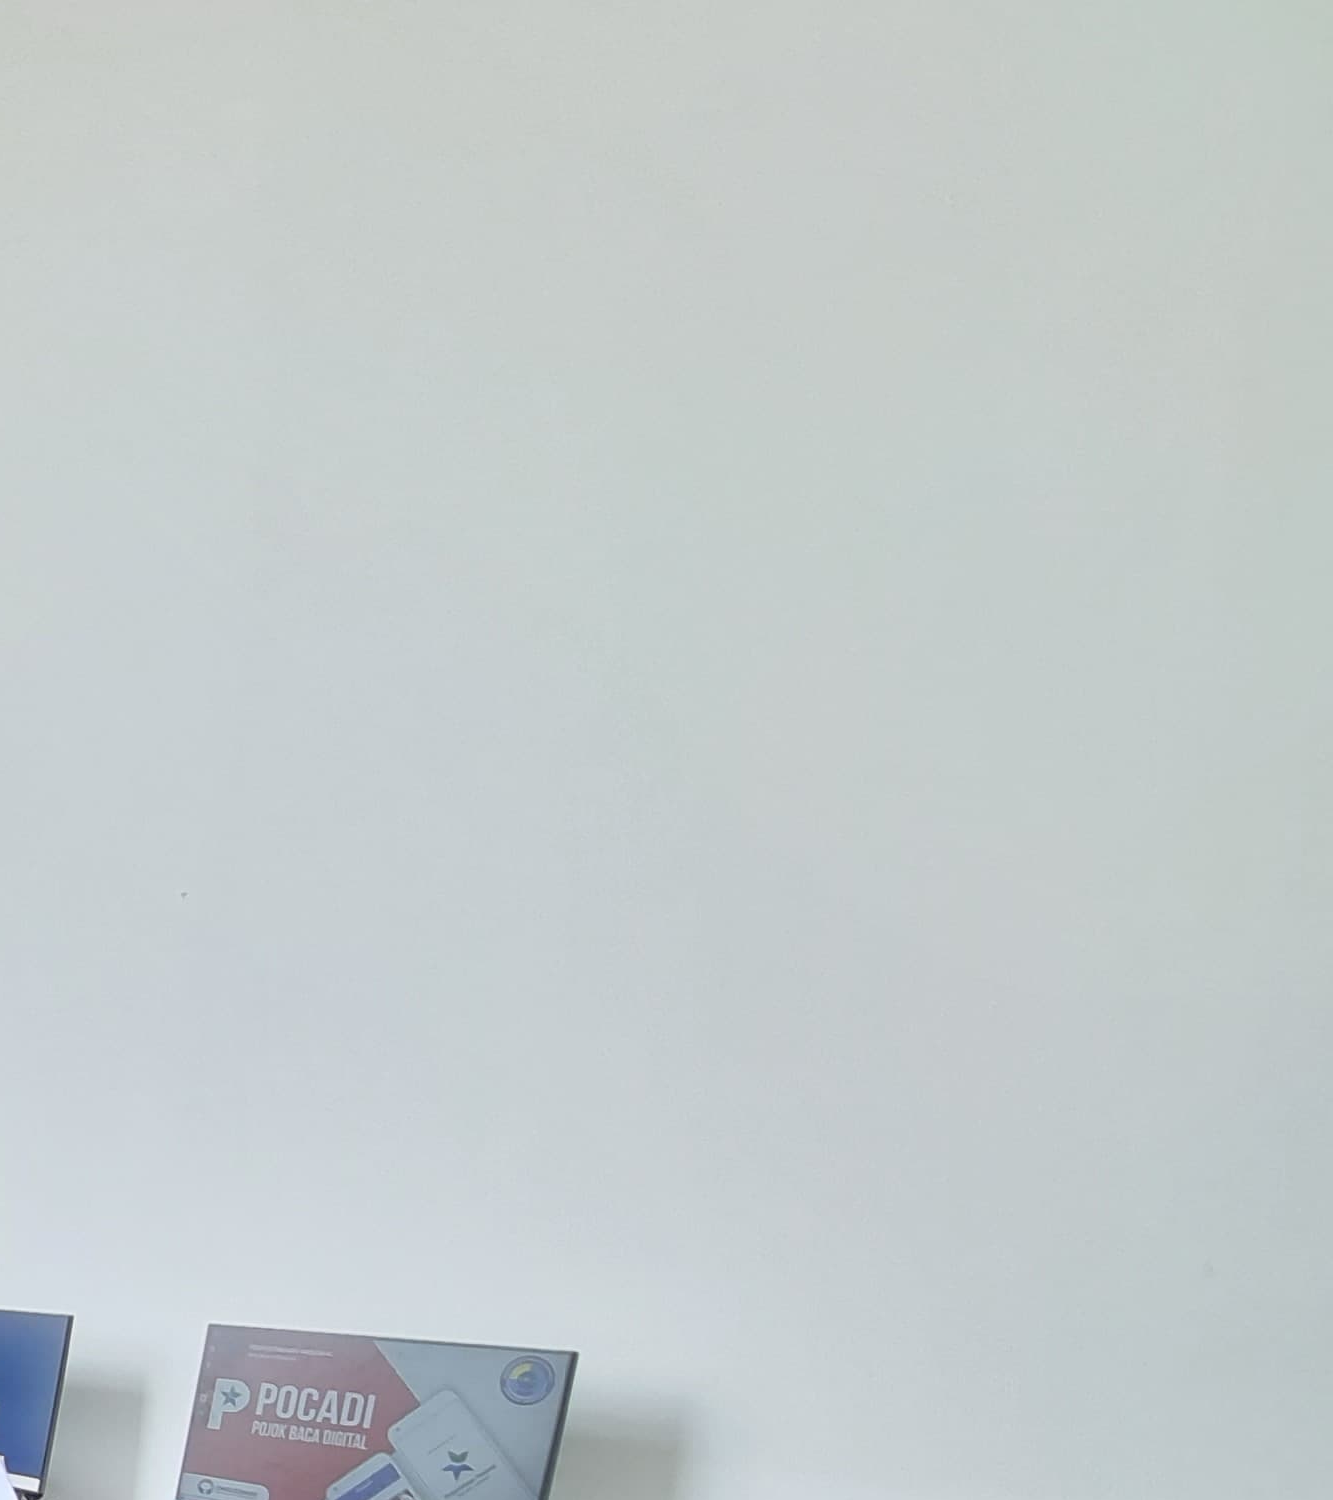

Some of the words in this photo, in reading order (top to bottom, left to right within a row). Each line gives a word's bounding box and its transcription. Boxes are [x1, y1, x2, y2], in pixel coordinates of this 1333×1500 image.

[255, 1382, 377, 1429] POCADI
[251, 1420, 287, 1439] POJOK
[288, 1427, 320, 1444] BACA
[322, 1430, 369, 1450] DIGITAL
